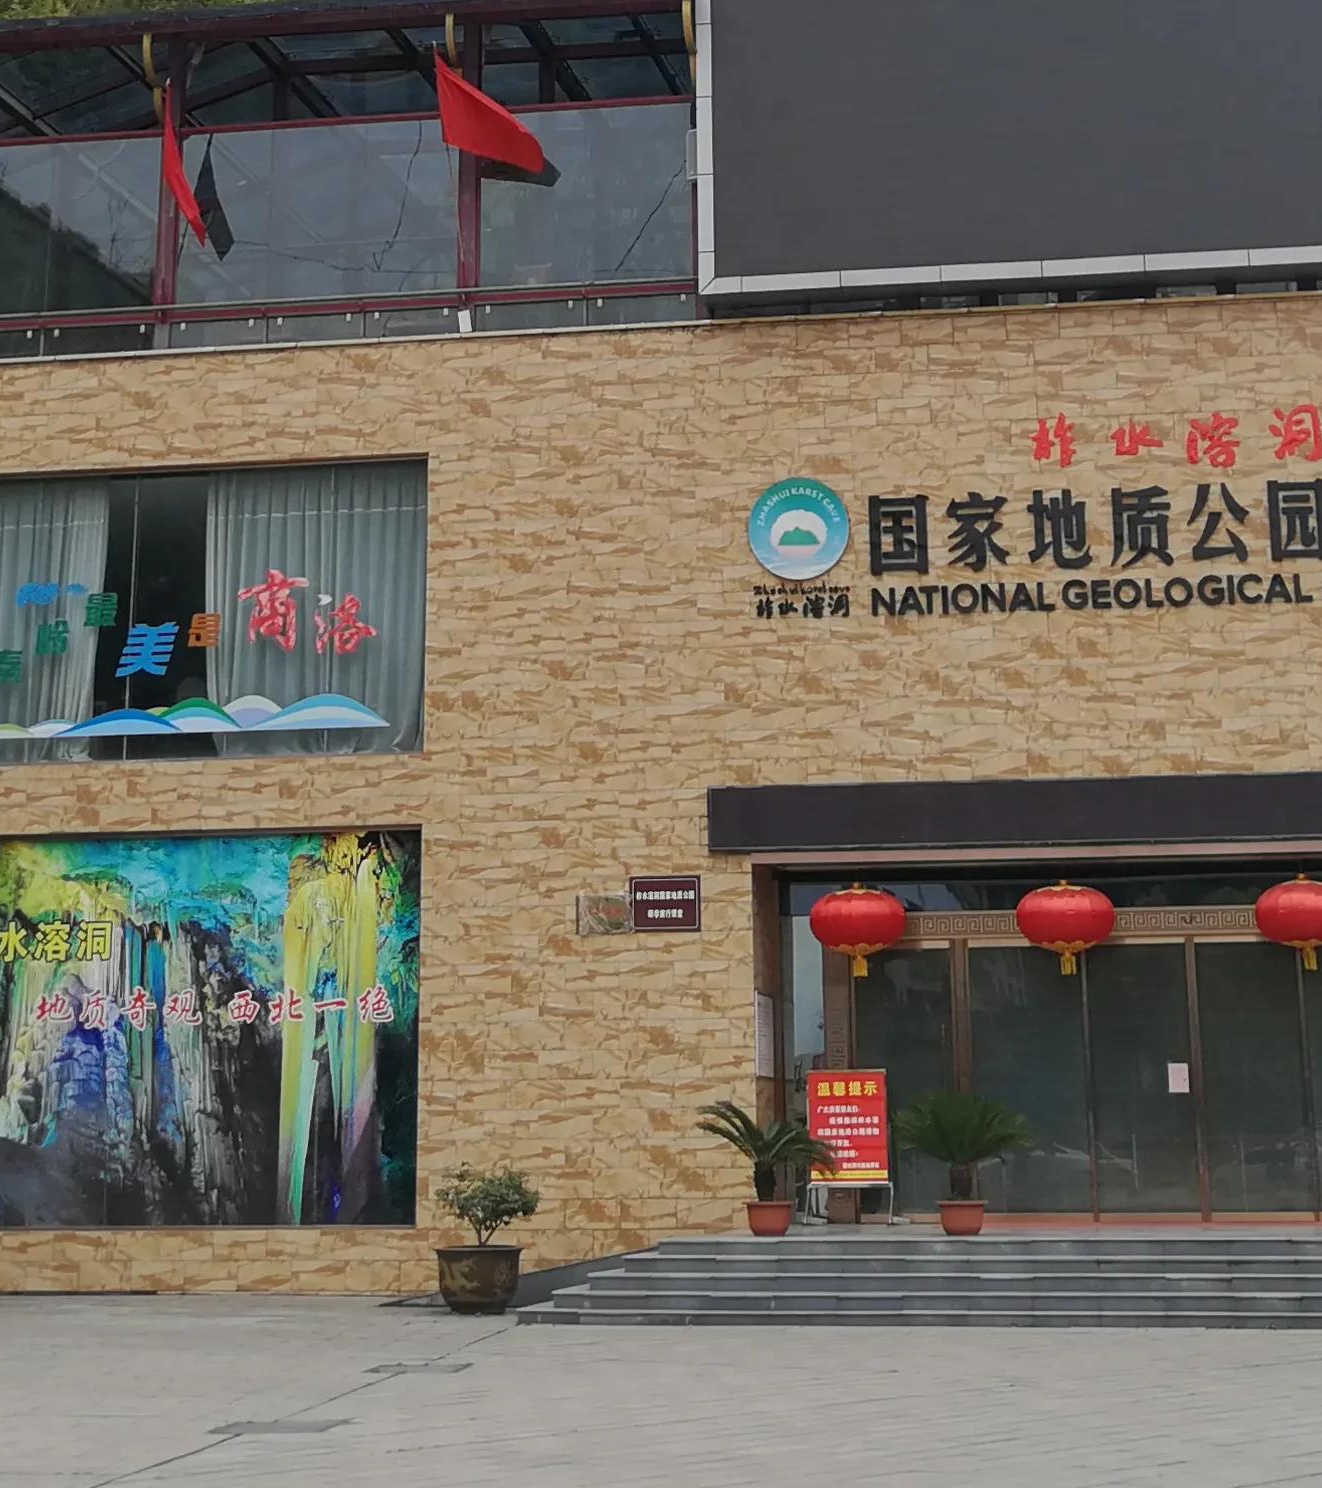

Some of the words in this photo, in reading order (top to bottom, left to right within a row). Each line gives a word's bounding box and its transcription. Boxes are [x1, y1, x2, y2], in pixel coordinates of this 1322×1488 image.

[791, 487, 824, 502] KARST
[870, 581, 1056, 618] NATIONAL
[1061, 572, 1314, 611] GEOLOGICAL
[34, 989, 203, 1031] 地质奇观
[228, 986, 396, 1025] 西北一绝
[816, 1080, 878, 1097] 温馨提示
